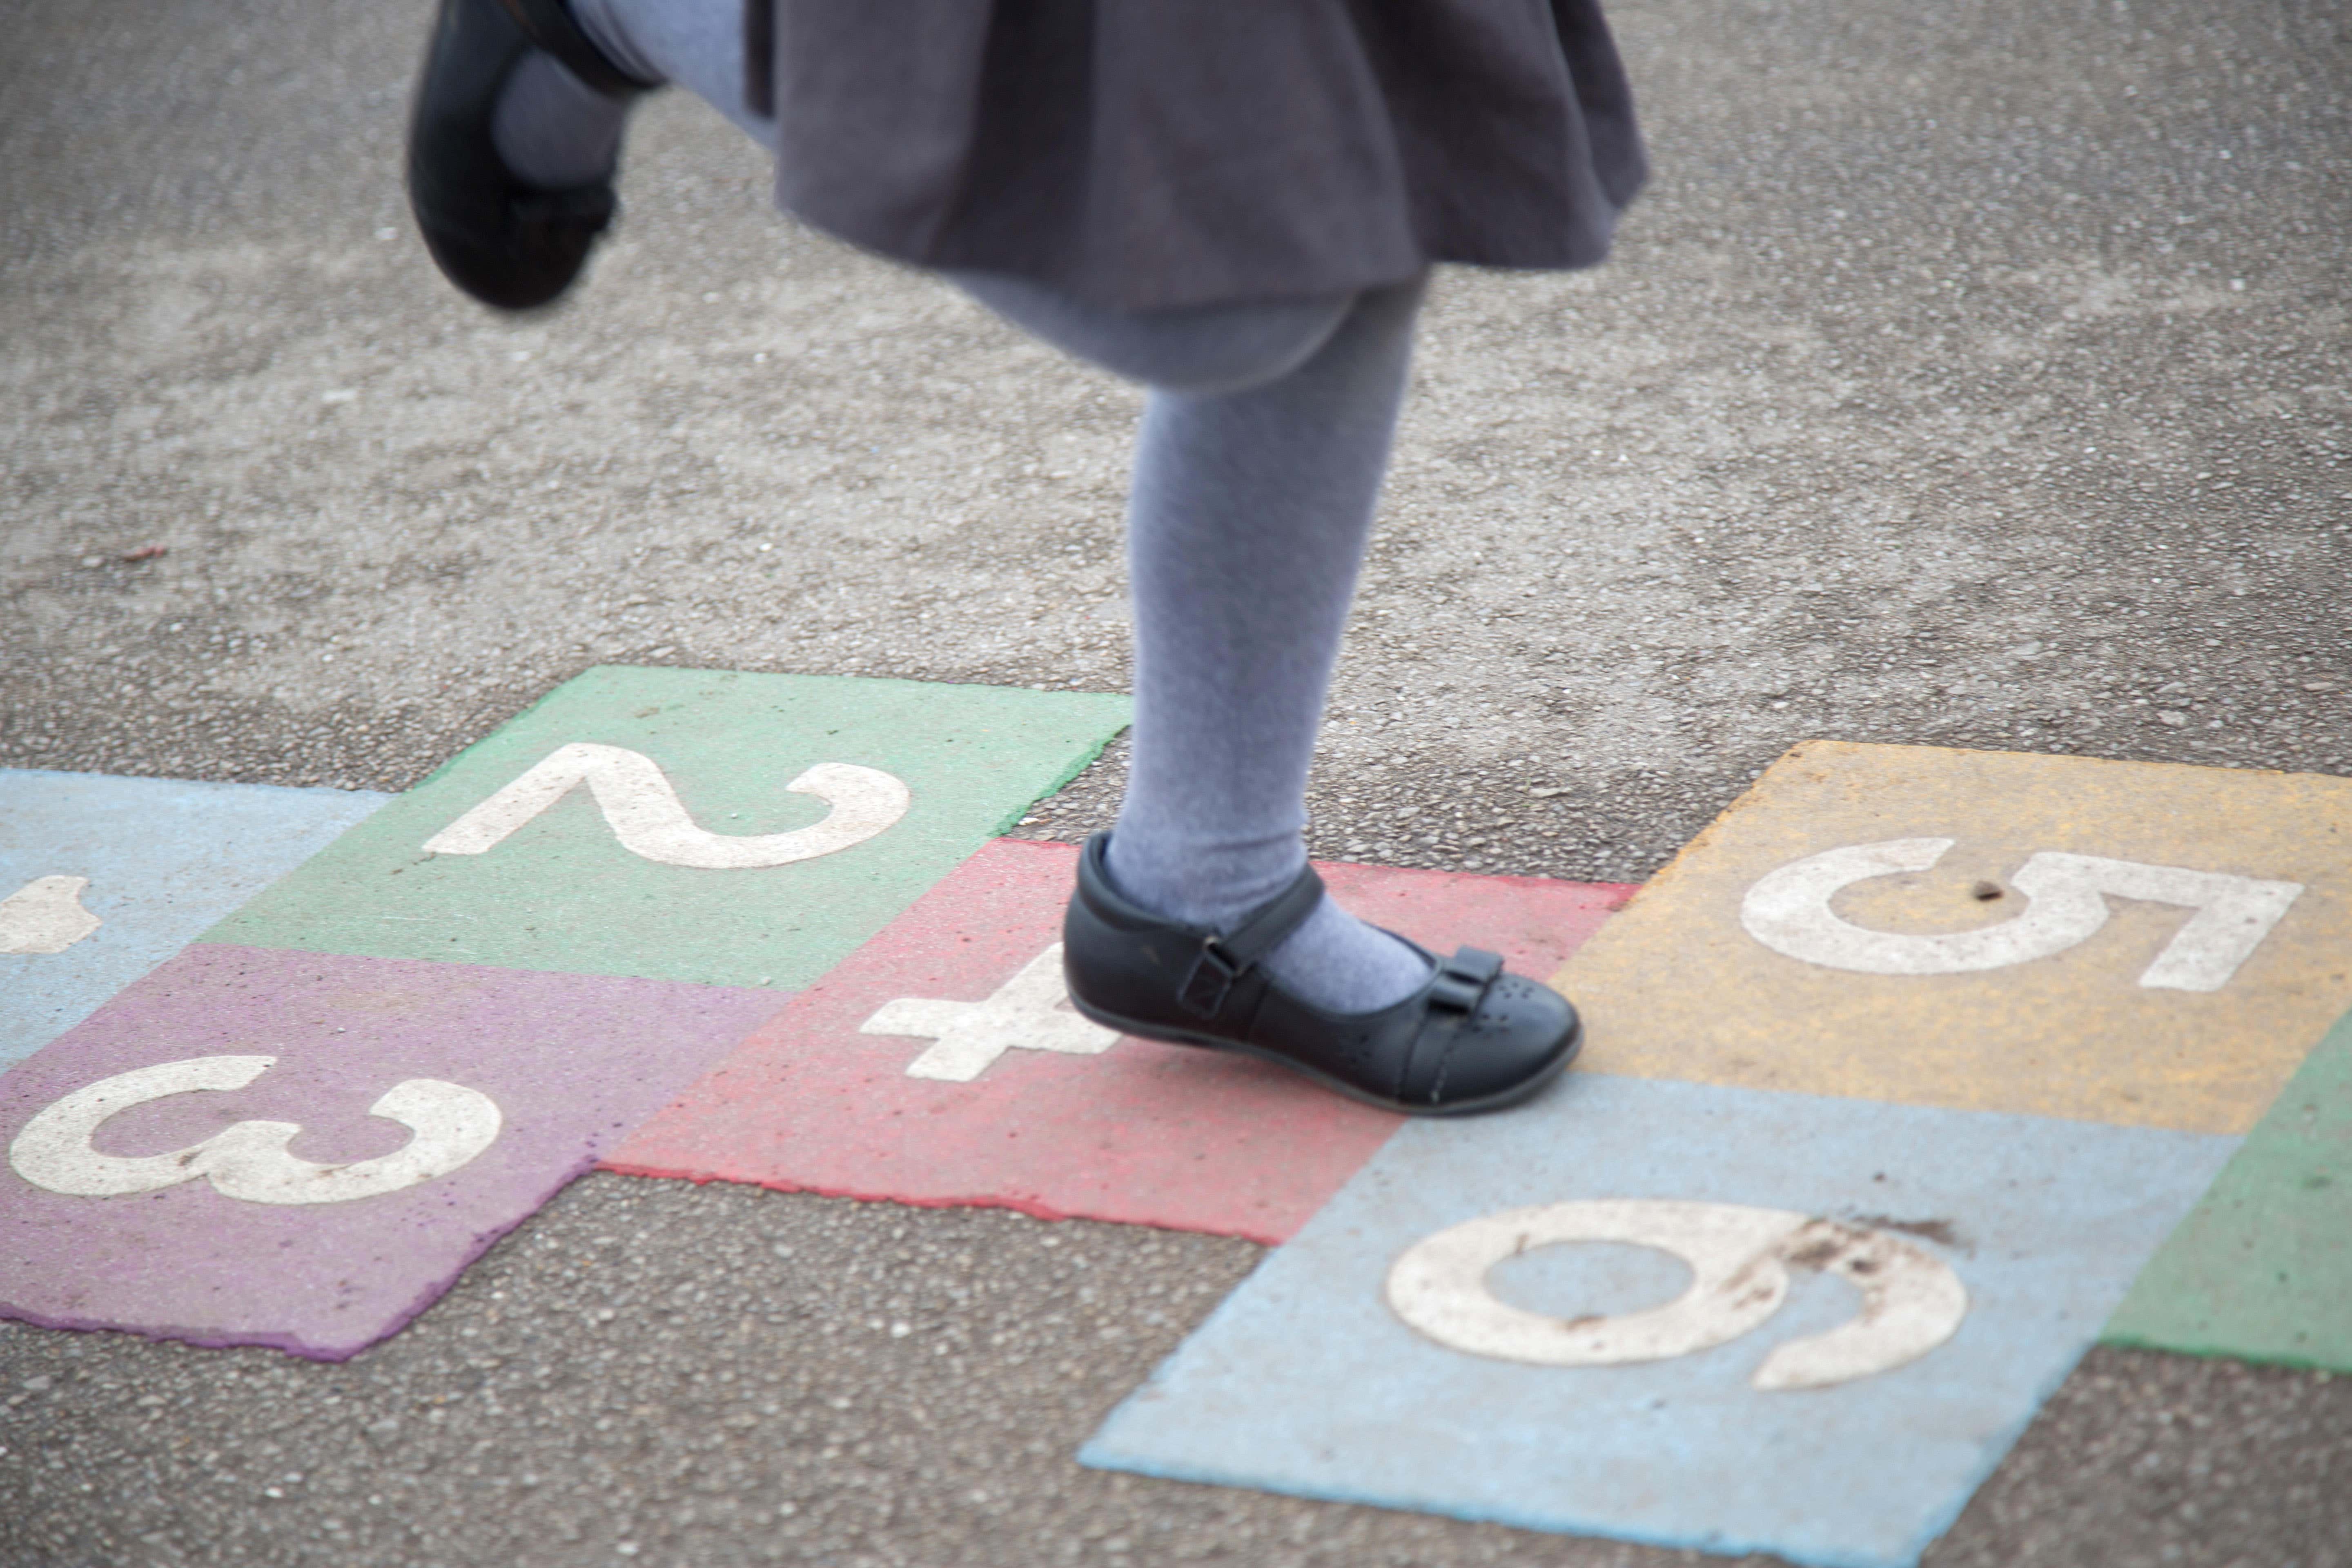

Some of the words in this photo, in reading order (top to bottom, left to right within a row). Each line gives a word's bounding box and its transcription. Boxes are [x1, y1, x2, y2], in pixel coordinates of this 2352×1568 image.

[422, 742, 911, 869] 2
[1740, 837, 2305, 991] 5
[10, 1056, 503, 1204] 3
[1388, 1199, 1967, 1391] 6
